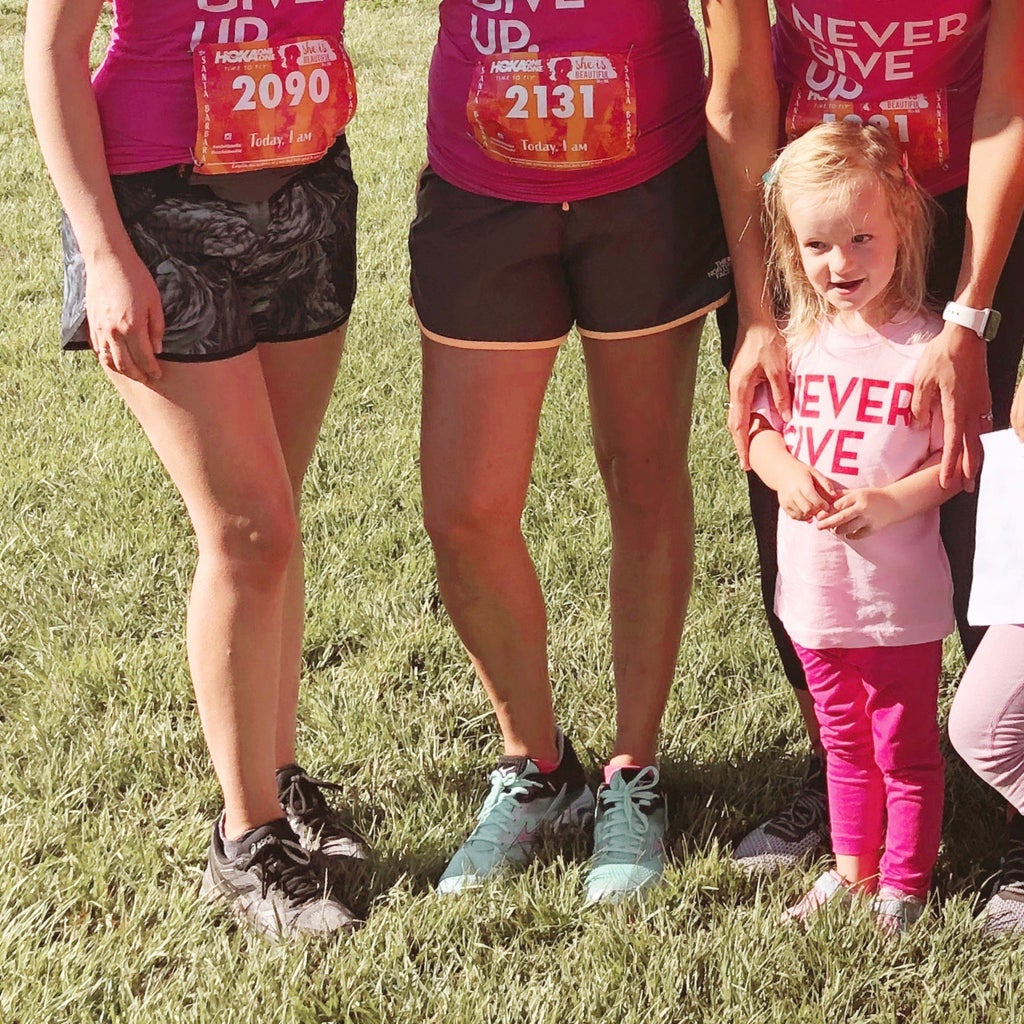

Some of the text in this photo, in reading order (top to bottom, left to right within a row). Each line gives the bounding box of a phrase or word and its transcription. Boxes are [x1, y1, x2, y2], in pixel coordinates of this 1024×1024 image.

[470, 13, 540, 56] UP.
[791, 2, 968, 48] NEVER
[808, 38, 914, 81] GIVE
[232, 68, 330, 111] 2090
[504, 84, 594, 119] 2131
